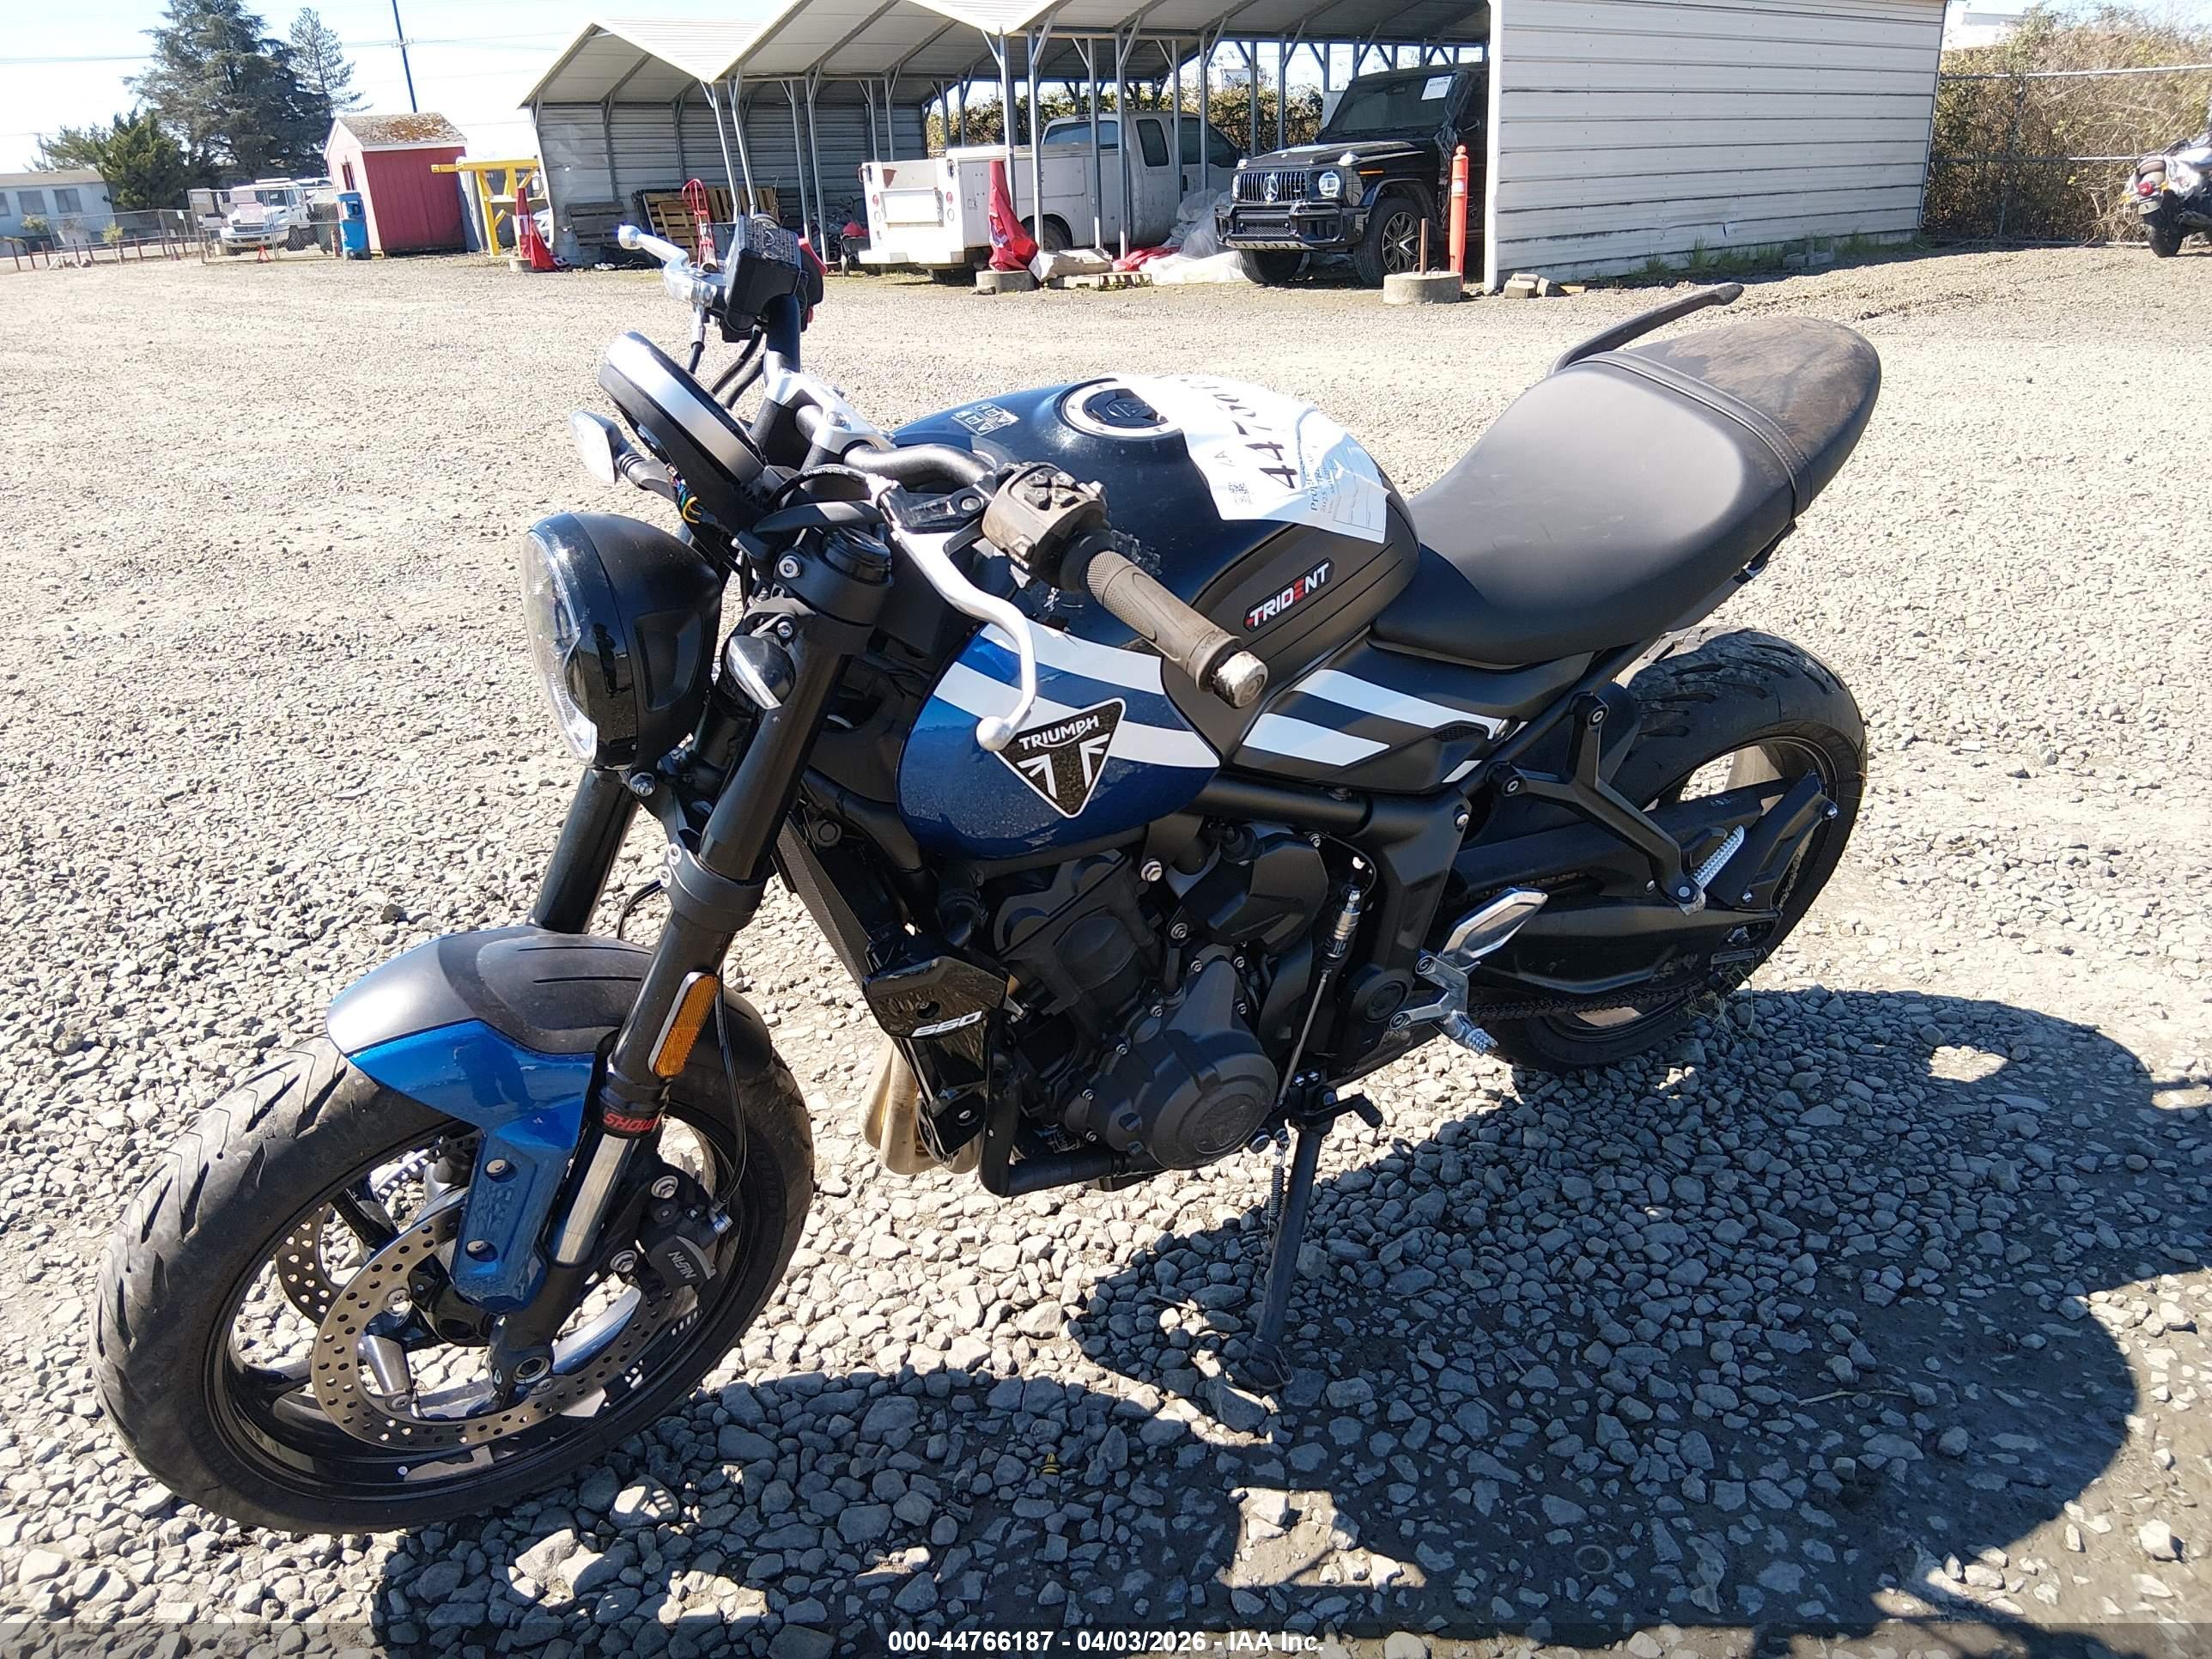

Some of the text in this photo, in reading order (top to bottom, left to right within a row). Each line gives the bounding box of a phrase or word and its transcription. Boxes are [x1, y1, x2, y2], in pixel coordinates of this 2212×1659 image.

[1248, 562, 1329, 627] TRIDENT
[1018, 714, 1100, 750] TRIUMPH
[911, 1010, 982, 1037] 660
